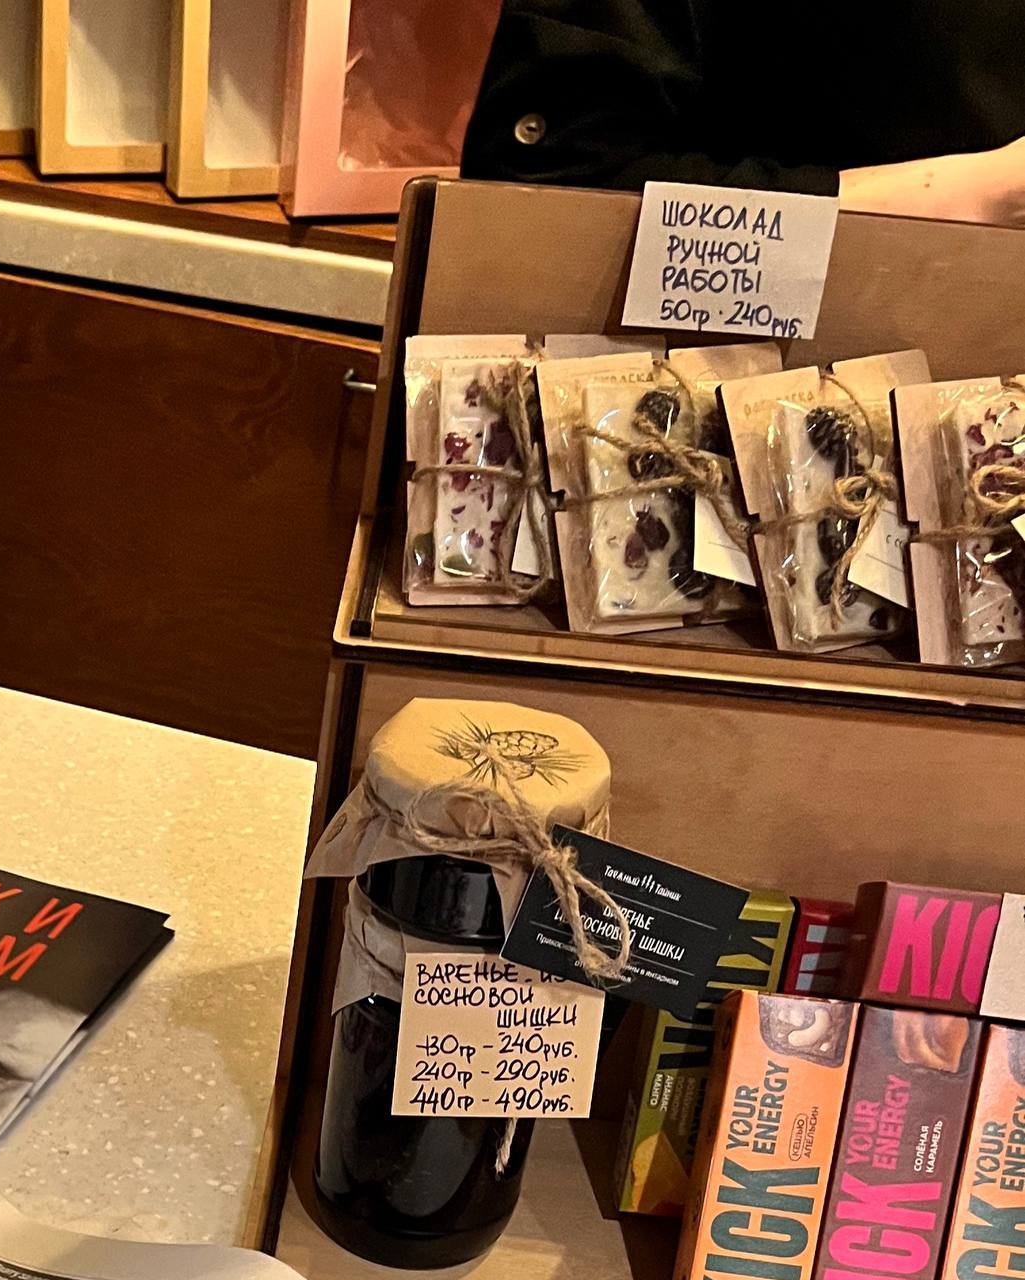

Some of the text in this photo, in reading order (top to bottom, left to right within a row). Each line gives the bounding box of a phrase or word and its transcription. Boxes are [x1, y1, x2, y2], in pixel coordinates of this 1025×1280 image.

[662, 200, 784, 241] ШОКОЛАД
[667, 235, 761, 266] РУЧНОЙ
[662, 265, 762, 294] РАБОТЫ
[580, 913, 636, 944] СОСНОВЙ
[638, 935, 686, 961] ШИШКИ
[602, 905, 655, 931] ВРЕНЬЕ
[416, 961, 519, 986] ВАРЕНЬЕ
[497, 1004, 577, 1030] ШИШКИ
[411, 1060, 473, 1090] 240гр
[493, 1059, 576, 1090] 290руб.
[649, 1073, 664, 1106] МАНГО
[659, 1074, 675, 1112] АНАНАС
[409, 1083, 474, 1114] 440гр
[494, 1087, 574, 1114] 490руб.
[725, 1084, 760, 1151] YOUR
[751, 1060, 790, 1155] ENERGY
[845, 1098, 881, 1166] YOUR
[871, 1073, 912, 1171] ENERGY
[913, 1124, 930, 1173] СОЛЁНАЯ
[925, 1119, 944, 1175] КАРАМЕЛЬ
[972, 1120, 1008, 1188] YOUR
